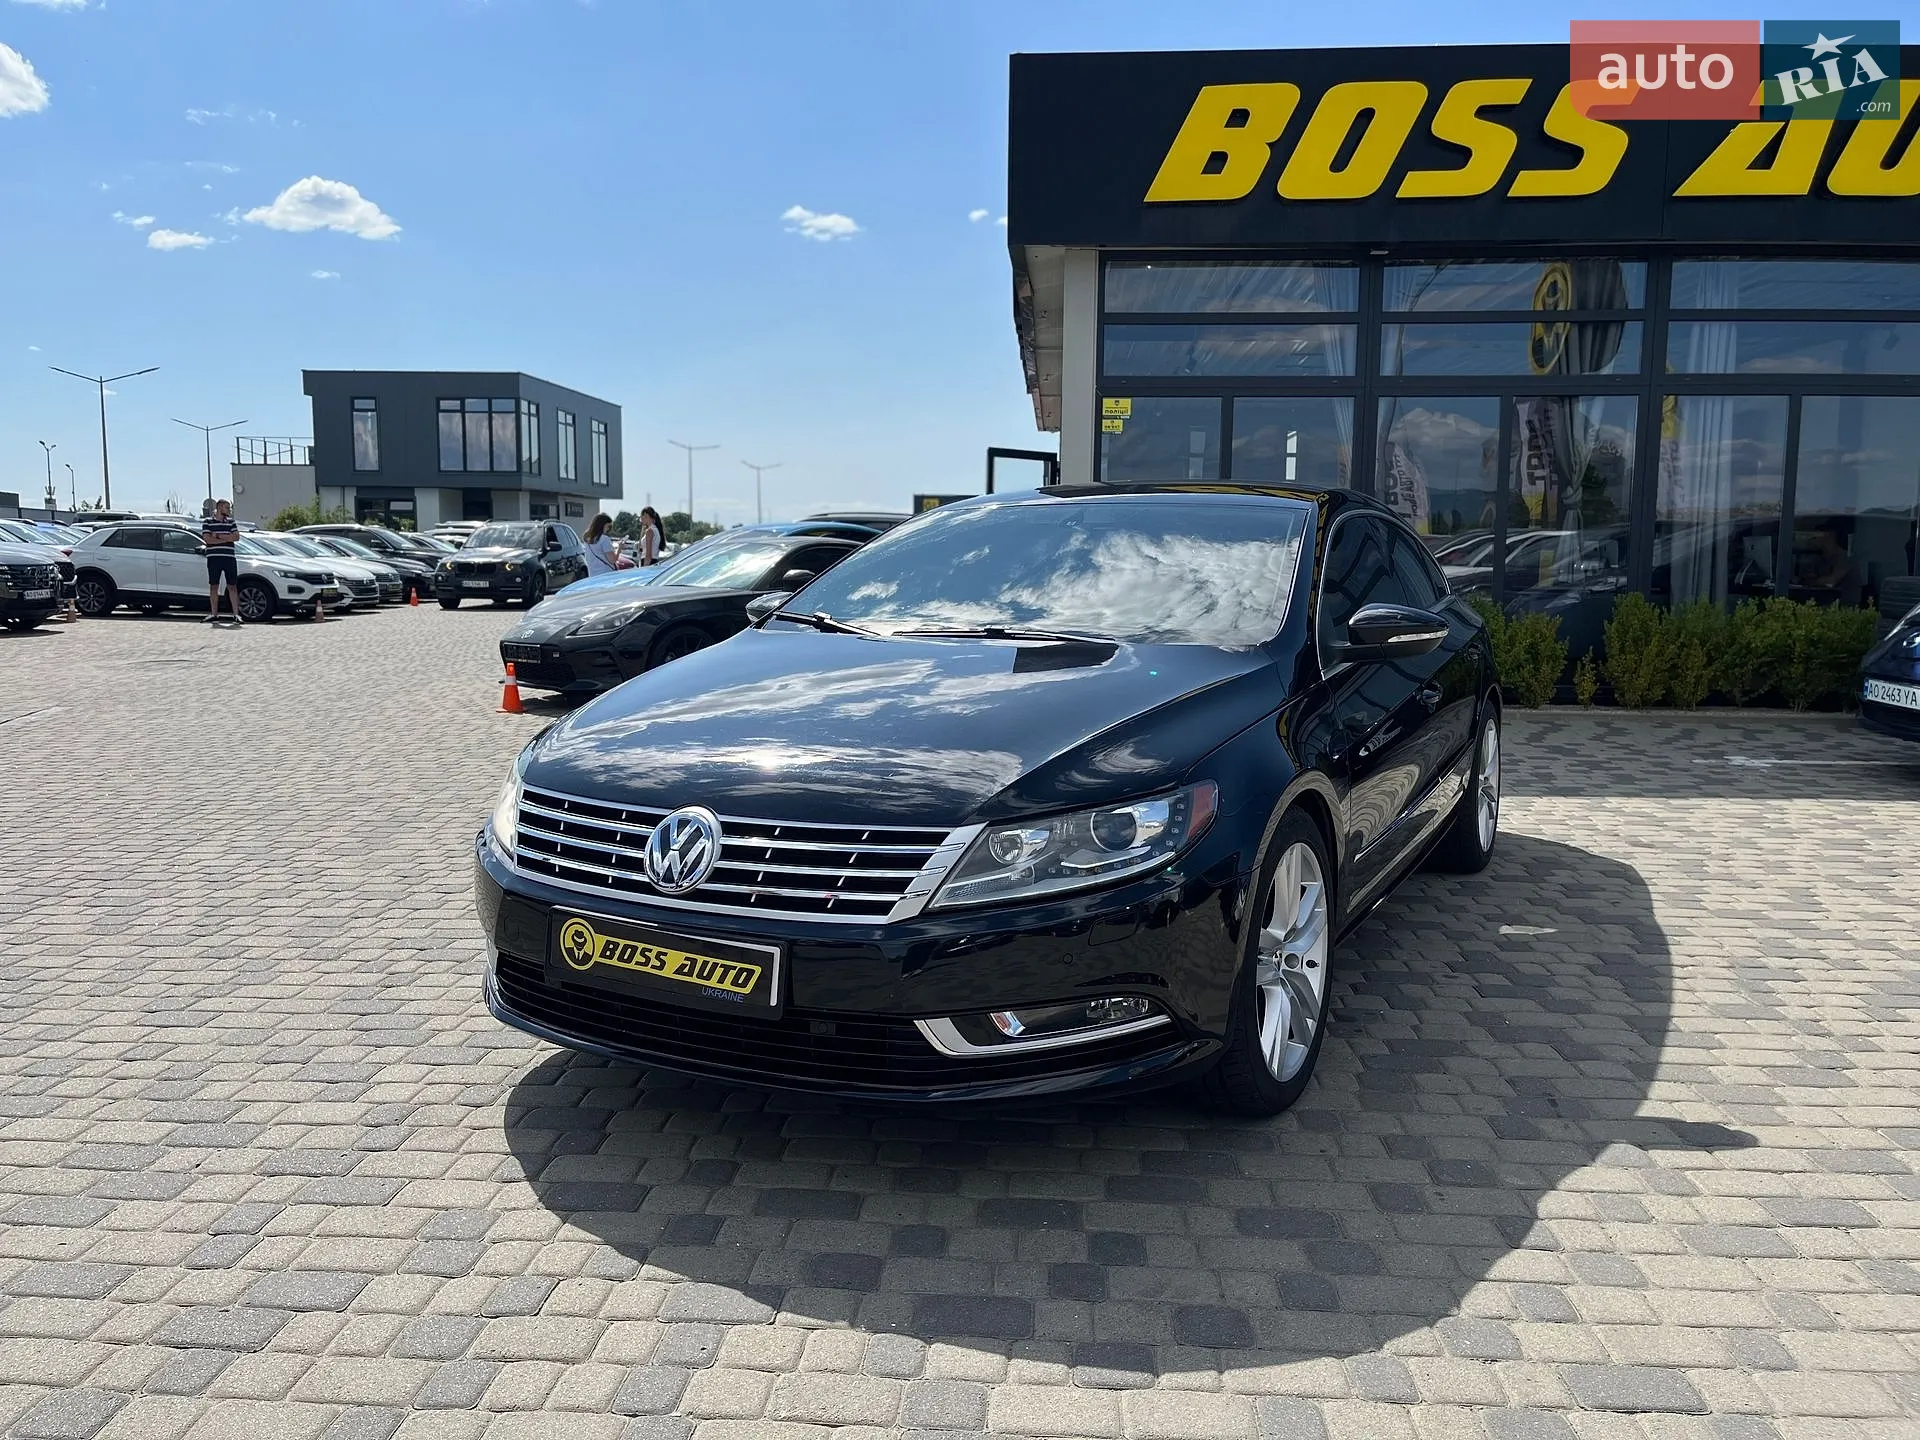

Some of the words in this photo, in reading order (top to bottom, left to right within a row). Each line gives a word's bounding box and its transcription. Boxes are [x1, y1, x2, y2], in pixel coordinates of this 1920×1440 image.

[1144, 79, 1640, 202] BOSS
[1881, 686, 1902, 703] 2463
[1904, 689, 1918, 706] YA
[599, 939, 668, 971] BOSS
[673, 956, 756, 988] AUTO
[702, 986, 745, 1003] UKRAINE
